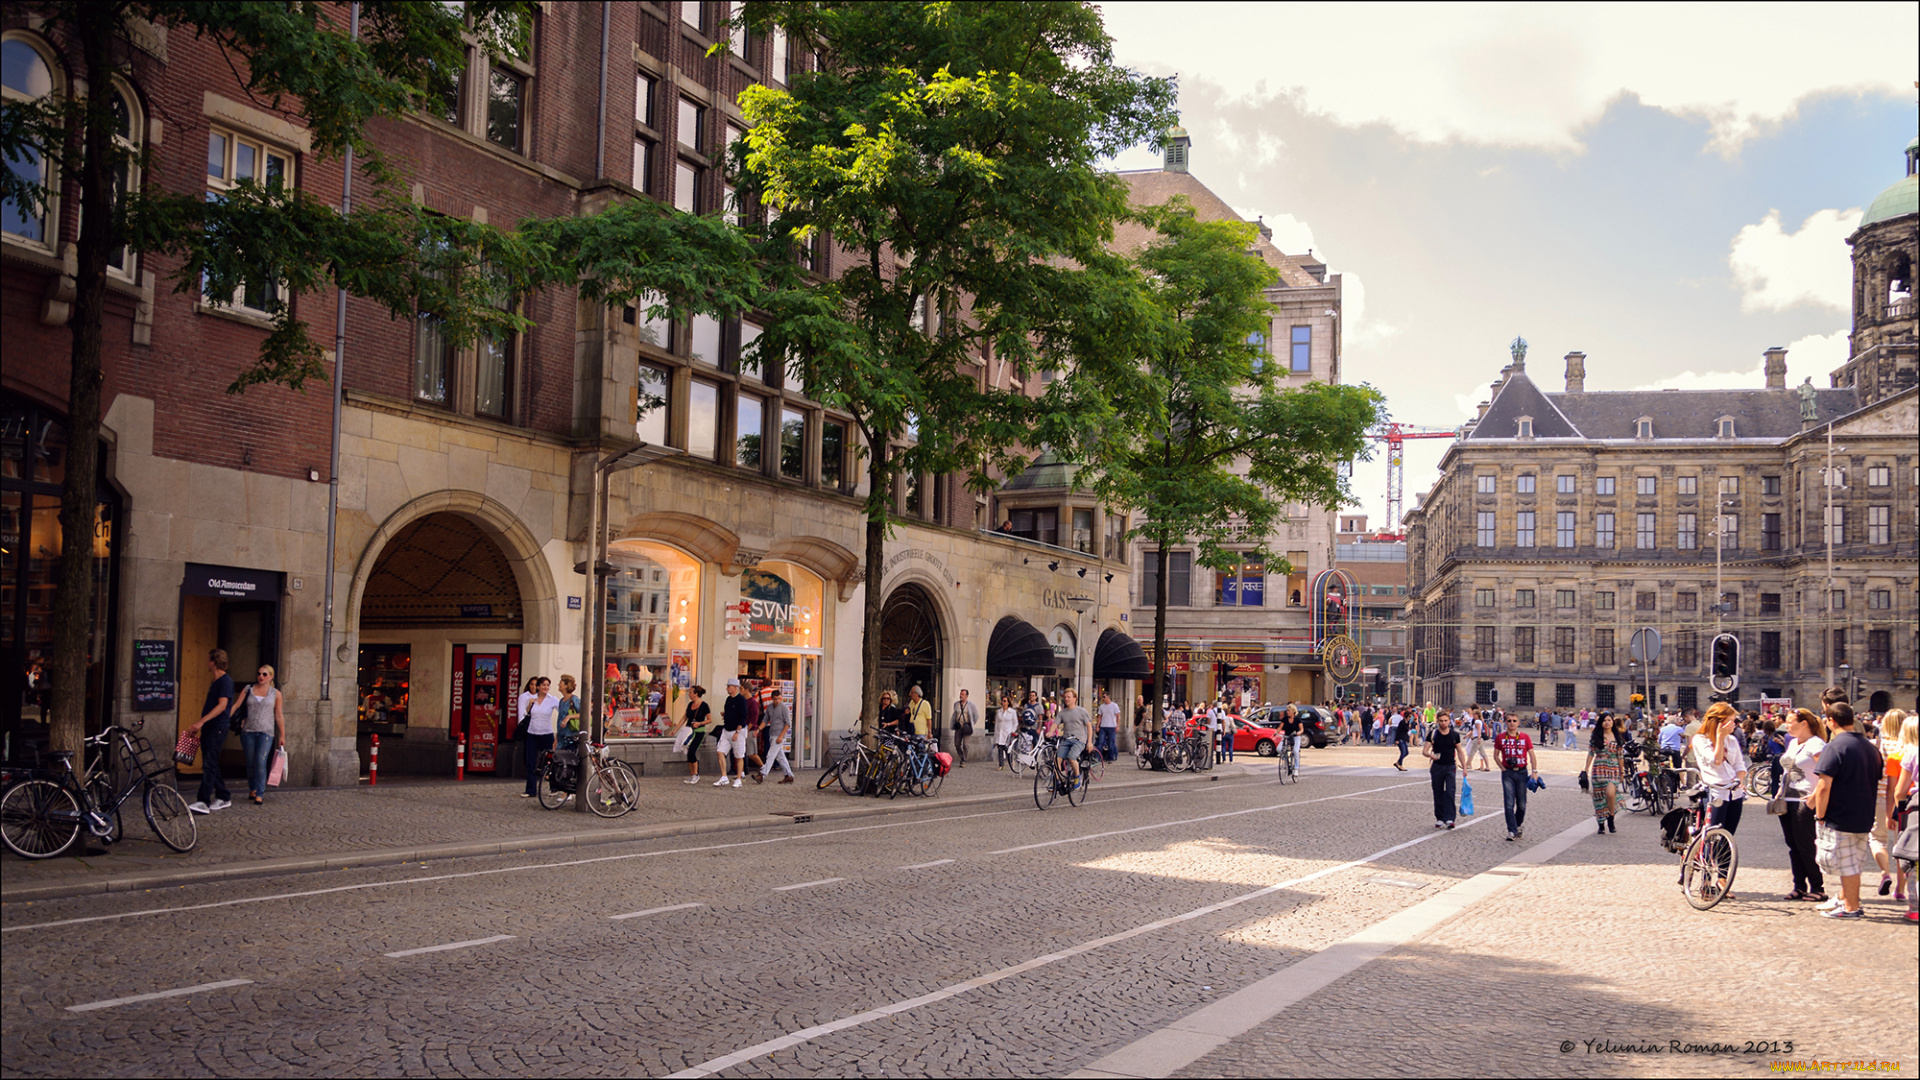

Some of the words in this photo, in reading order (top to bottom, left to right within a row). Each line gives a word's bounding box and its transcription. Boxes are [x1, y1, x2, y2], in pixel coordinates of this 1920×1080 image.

[924, 551, 944, 573] GROOTE
[208, 578, 221, 588] Old
[221, 579, 256, 590] Amsterdam
[1228, 582, 1263, 591] ZRRE
[751, 600, 811, 623] SVNRS
[751, 623, 775, 633] TOURS
[784, 626, 811, 635] TICKE
[453, 671, 464, 711] TOURS
[508, 666, 519, 718] TICKETS
